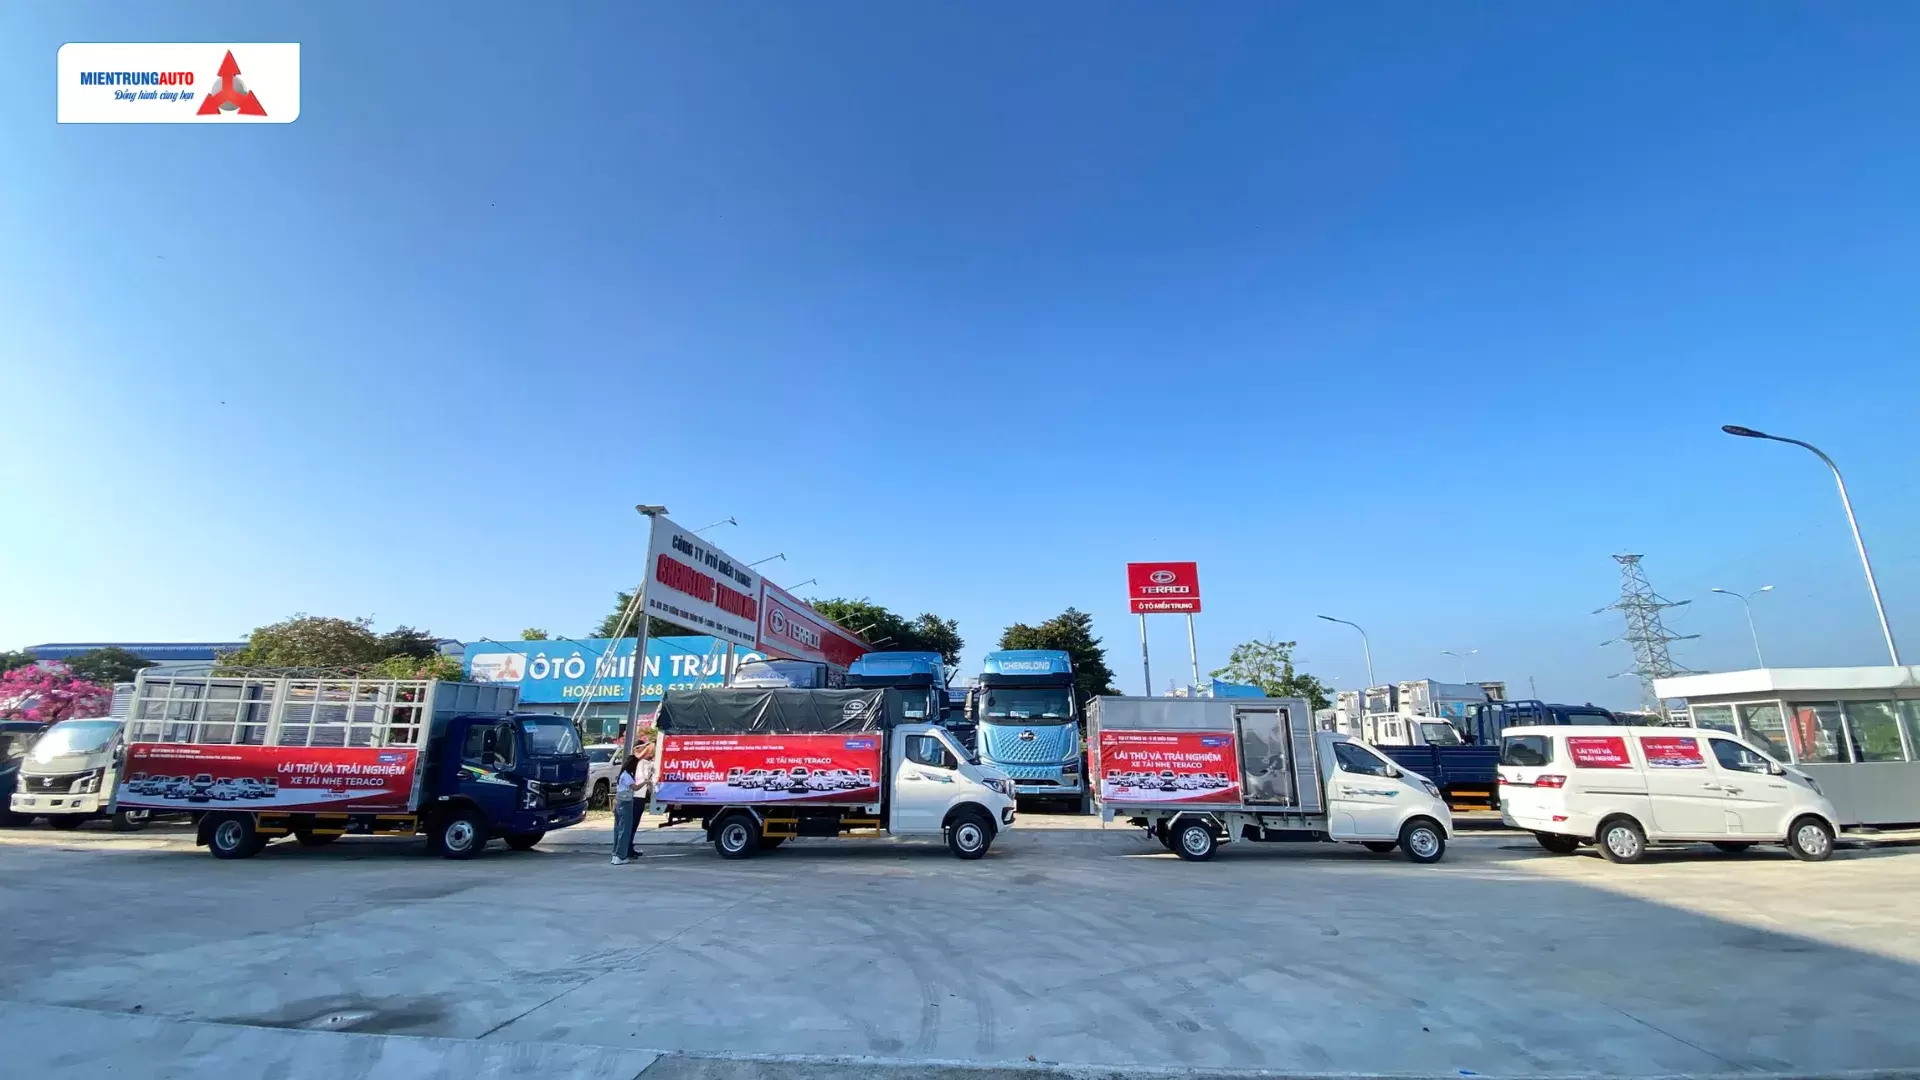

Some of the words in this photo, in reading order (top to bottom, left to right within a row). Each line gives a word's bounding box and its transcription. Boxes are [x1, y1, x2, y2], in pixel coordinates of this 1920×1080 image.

[672, 534, 694, 557] CÔNG
[695, 546, 704, 562] TY
[704, 550, 719, 570] ÔTÔ
[656, 553, 716, 603] CHENGLONG
[1140, 585, 1190, 594] TERACO
[1154, 601, 1169, 609] MIỀN
[785, 618, 821, 650] TERACO
[529, 652, 586, 680] ÔTÔ
[1003, 661, 1050, 670] CHENGLONG
[563, 684, 625, 697] HOTLINE:
[788, 757, 803, 765] NHẸ
[1114, 750, 1128, 760] LÁI
[1149, 752, 1162, 761] VÀ
[1163, 752, 1184, 761] TRẢI
[1185, 752, 1222, 763] NGHIỆM
[277, 762, 294, 773] LÁI
[319, 763, 334, 774] VÀ
[336, 762, 361, 774] TRẢI
[362, 762, 406, 777] NGHIỆM
[664, 759, 679, 769] LÁI
[701, 759, 715, 769] VÀ
[1155, 761, 1171, 770] NHẸ
[290, 776, 303, 784] XE
[322, 776, 343, 787] NHẸ
[345, 777, 384, 786] TERACO
[663, 770, 685, 780] TRẢI
[686, 770, 724, 782] NGHIỆM
